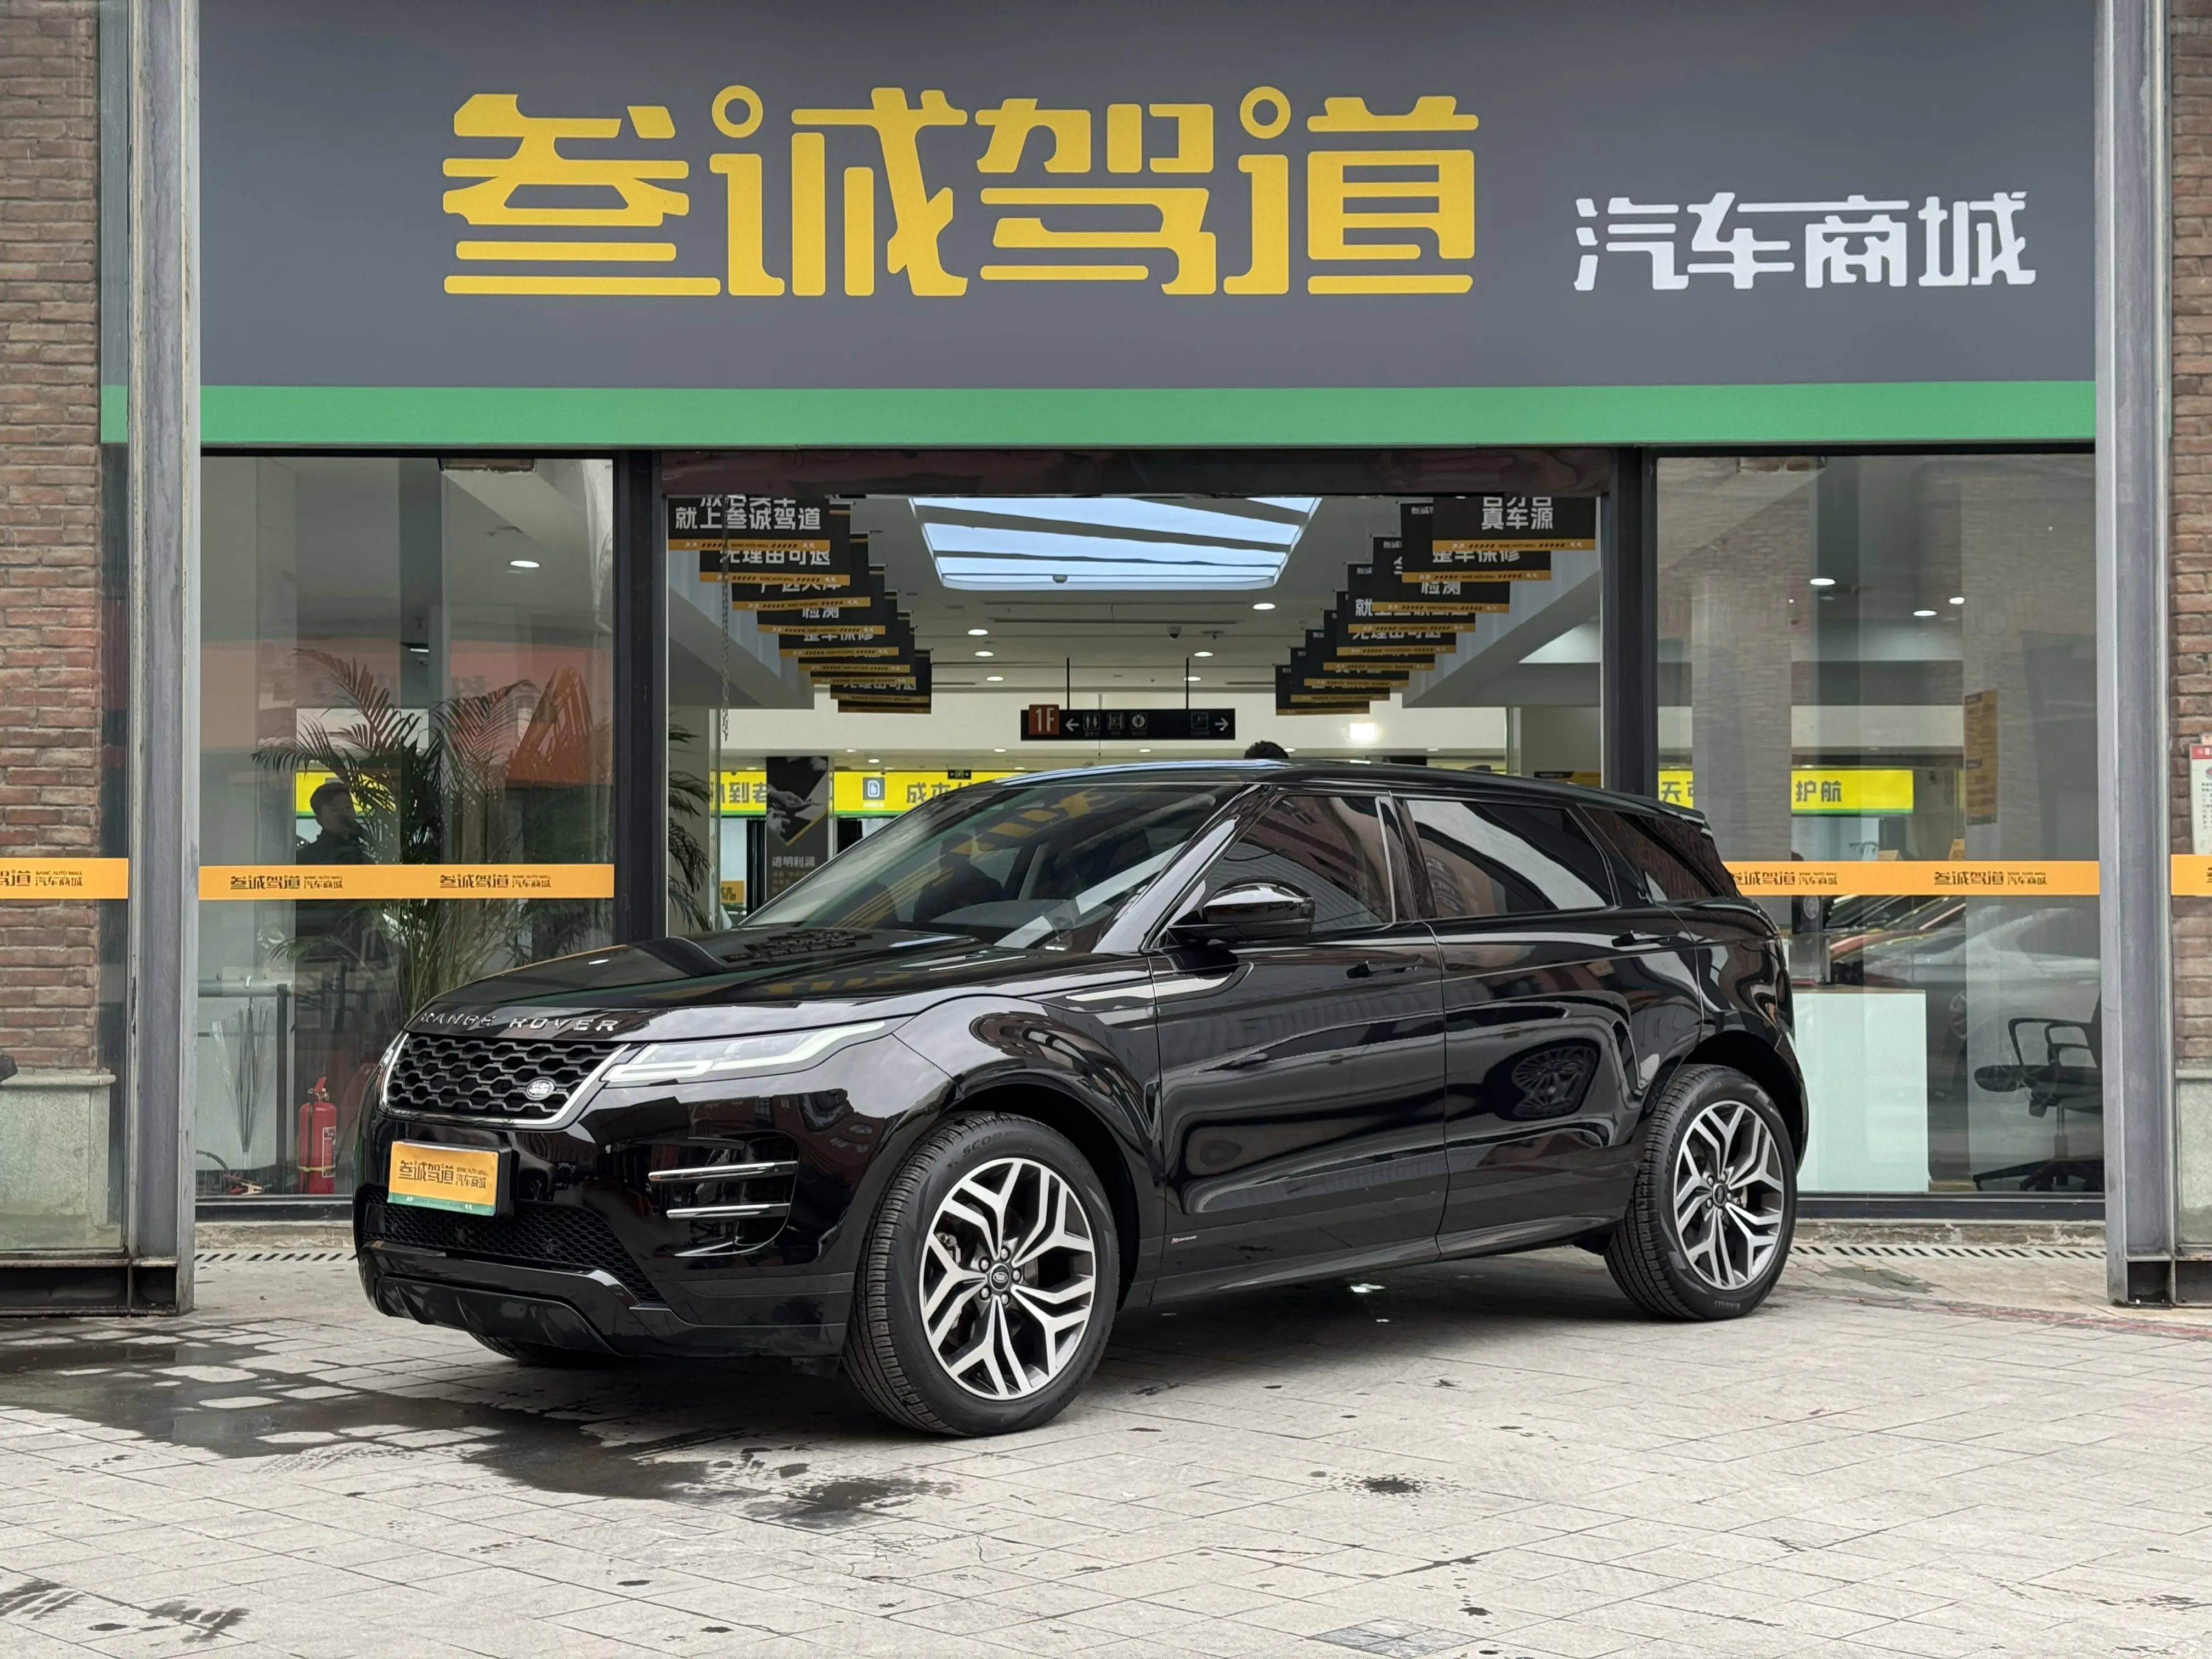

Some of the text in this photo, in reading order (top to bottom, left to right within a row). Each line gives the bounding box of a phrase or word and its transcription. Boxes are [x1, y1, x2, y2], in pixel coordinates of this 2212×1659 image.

[443, 86, 1479, 297] 叁诚驾道
[1573, 191, 2036, 291] 汽车商城
[675, 506, 821, 531] 就上叁诚驾道
[1481, 507, 1554, 531] 真车源
[1035, 707, 1055, 732] 1F
[1795, 780, 1842, 803] 护航
[421, 1012, 620, 1031] RANGE ROVER
[398, 1159, 455, 1186] 叁诚驾道
